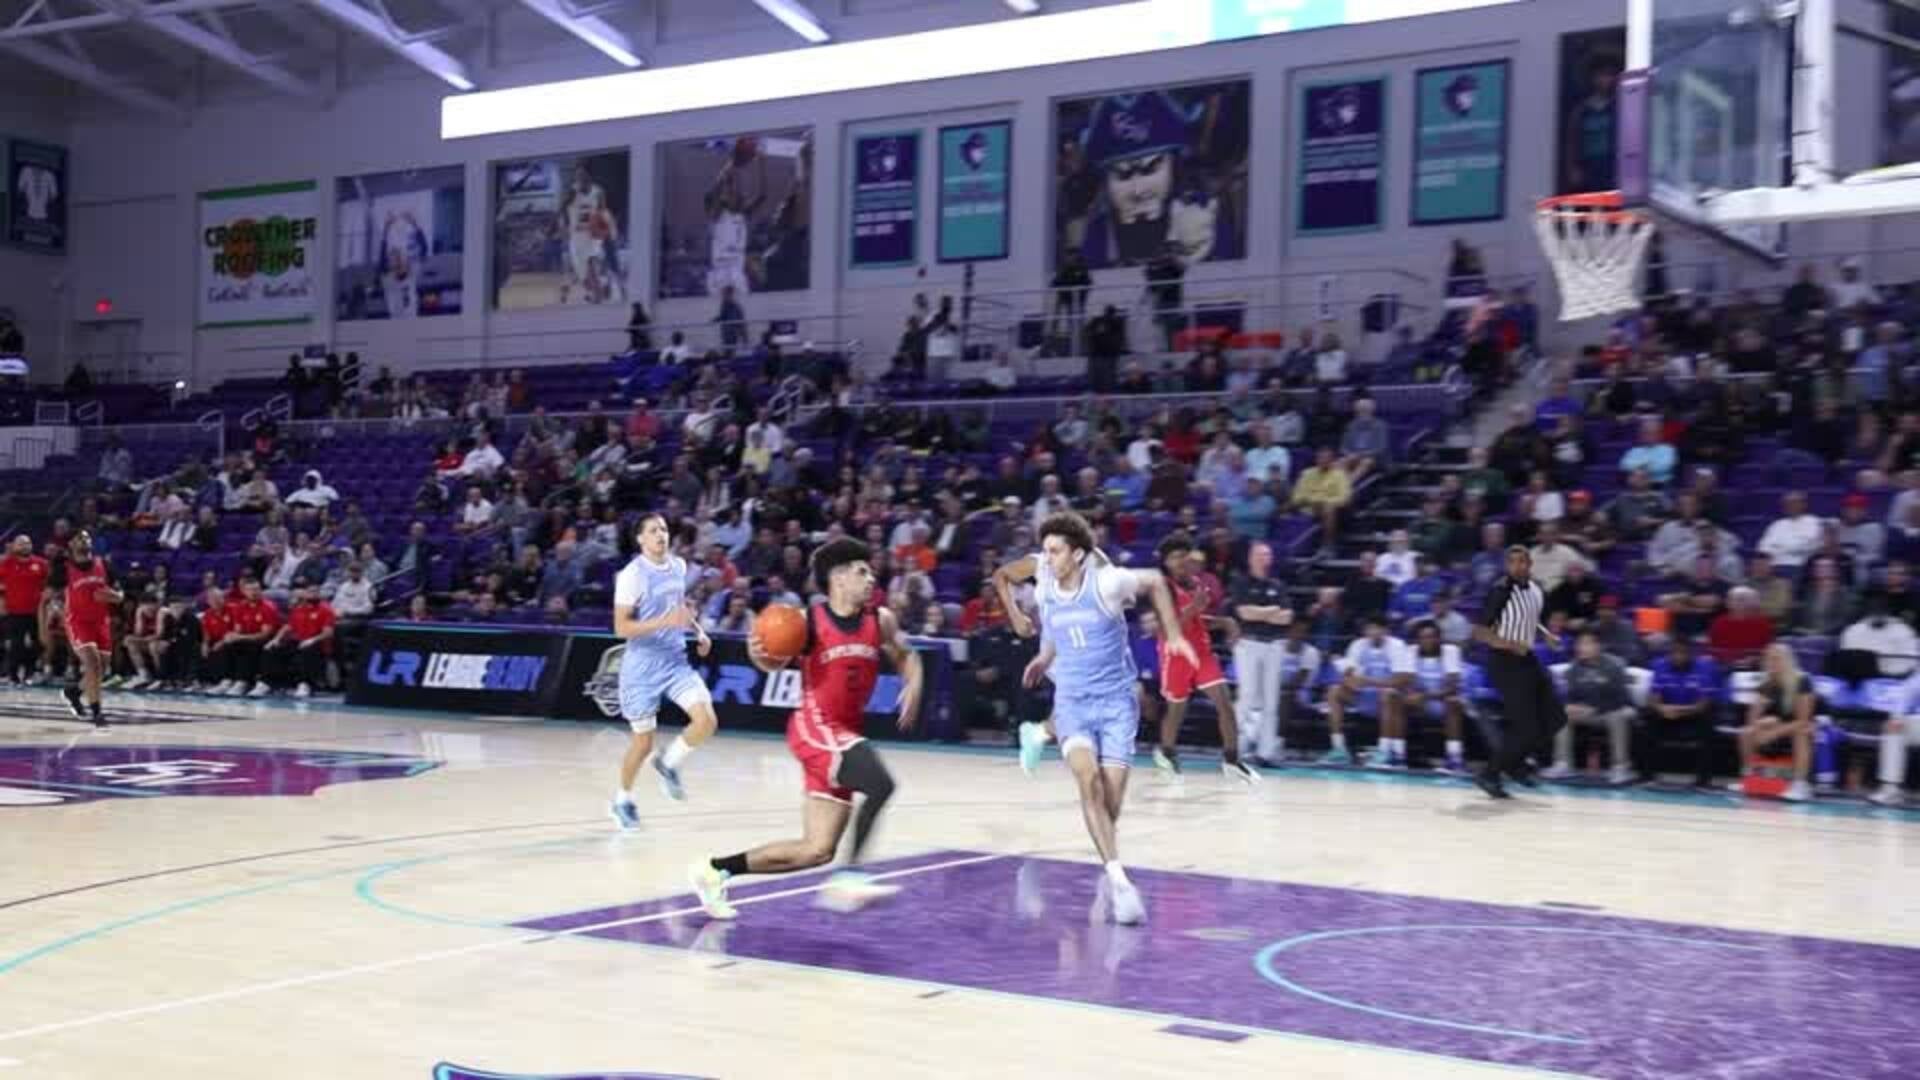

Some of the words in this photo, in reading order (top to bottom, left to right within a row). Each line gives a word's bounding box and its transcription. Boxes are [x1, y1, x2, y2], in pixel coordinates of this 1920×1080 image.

[205, 218, 316, 248] CROWTHER
[213, 247, 304, 275] ROOFING
[1068, 625, 1087, 648] 11
[367, 651, 421, 686] LR
